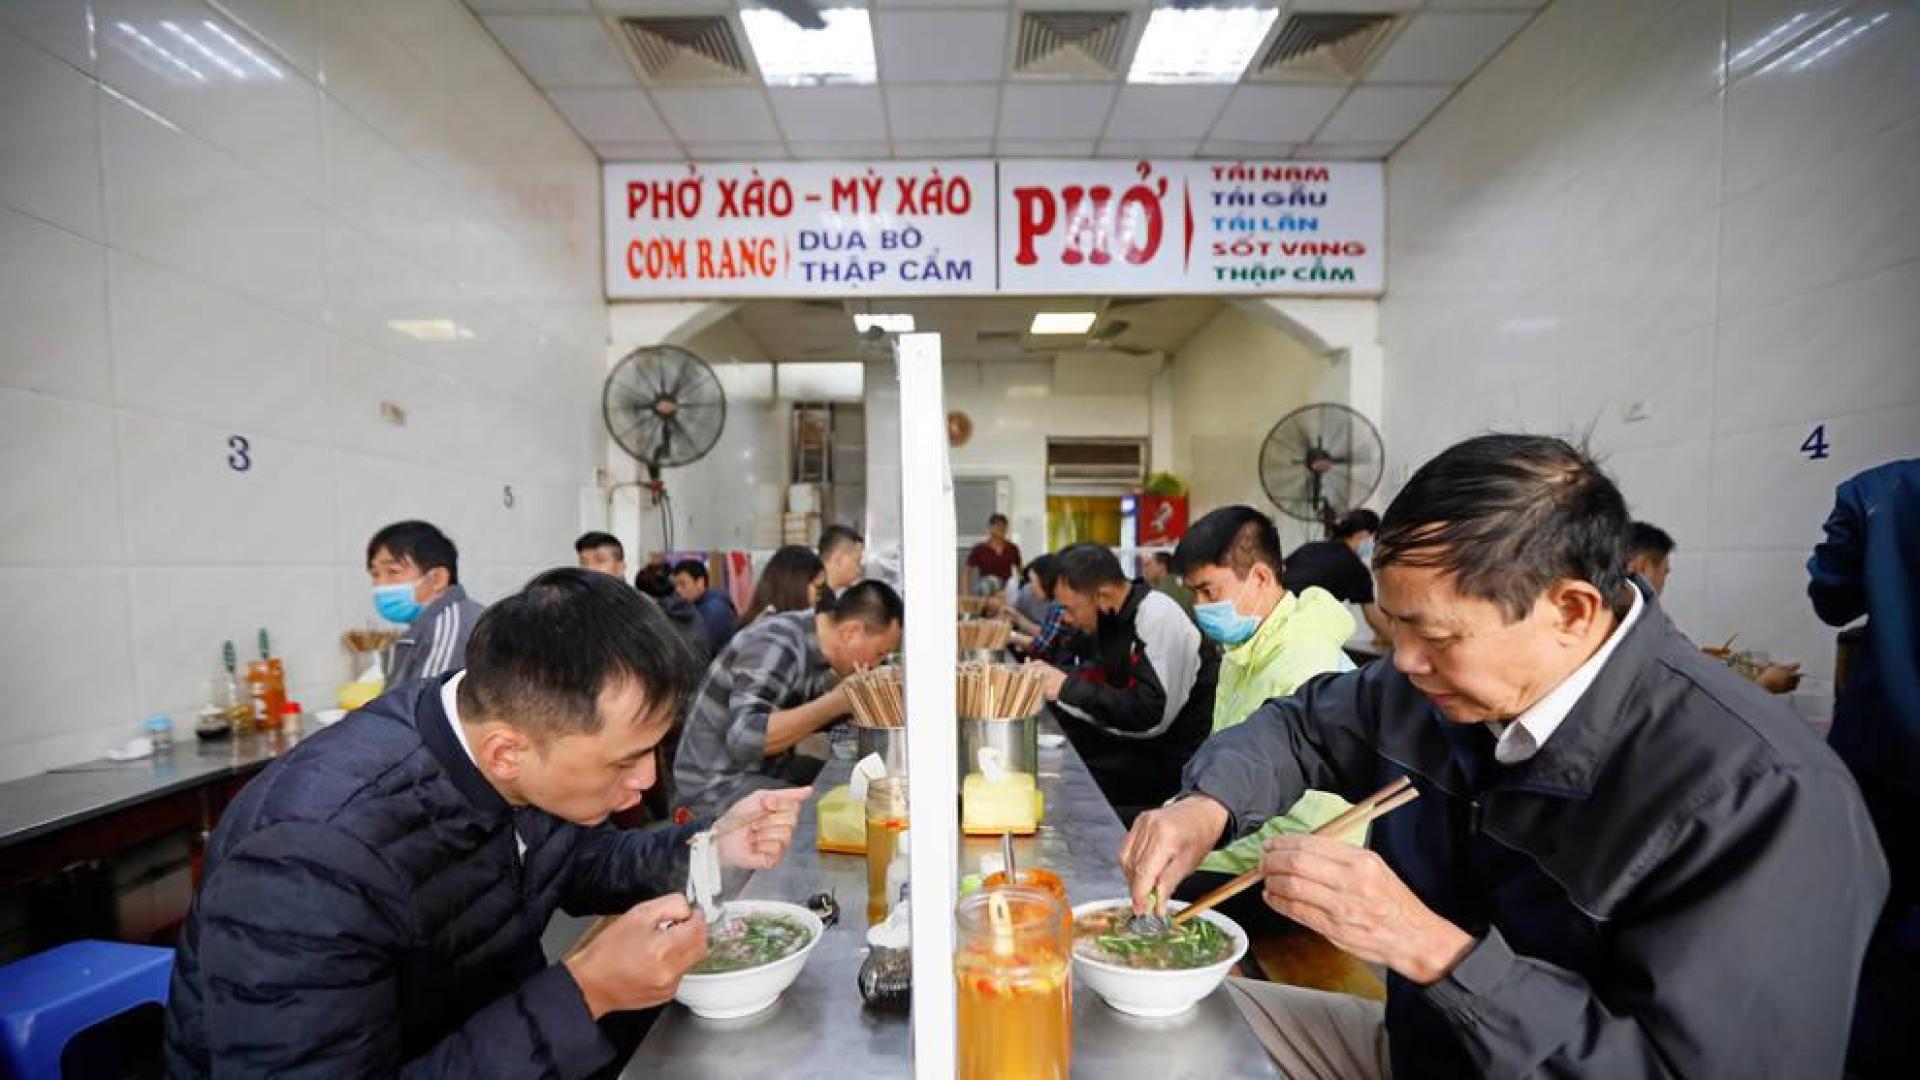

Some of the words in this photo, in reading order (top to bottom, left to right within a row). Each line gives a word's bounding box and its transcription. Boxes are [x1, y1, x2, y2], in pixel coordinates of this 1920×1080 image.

[627, 164, 704, 219] PHỞ
[717, 168, 793, 218] XÀO
[831, 168, 882, 215] MỲ
[896, 167, 971, 216] XÀO
[1212, 185, 1255, 206] TÁI
[1013, 161, 1168, 265] PHỞ
[627, 236, 687, 280] CƠM
[697, 238, 776, 280] RANG
[1212, 235, 1271, 256] SỐT
[800, 256, 886, 288] THẬP
[900, 248, 972, 281] CẨM
[1214, 262, 1286, 286] THẬP
[228, 434, 249, 472] 3
[1800, 424, 1829, 460] 4
[503, 484, 514, 508] 5
